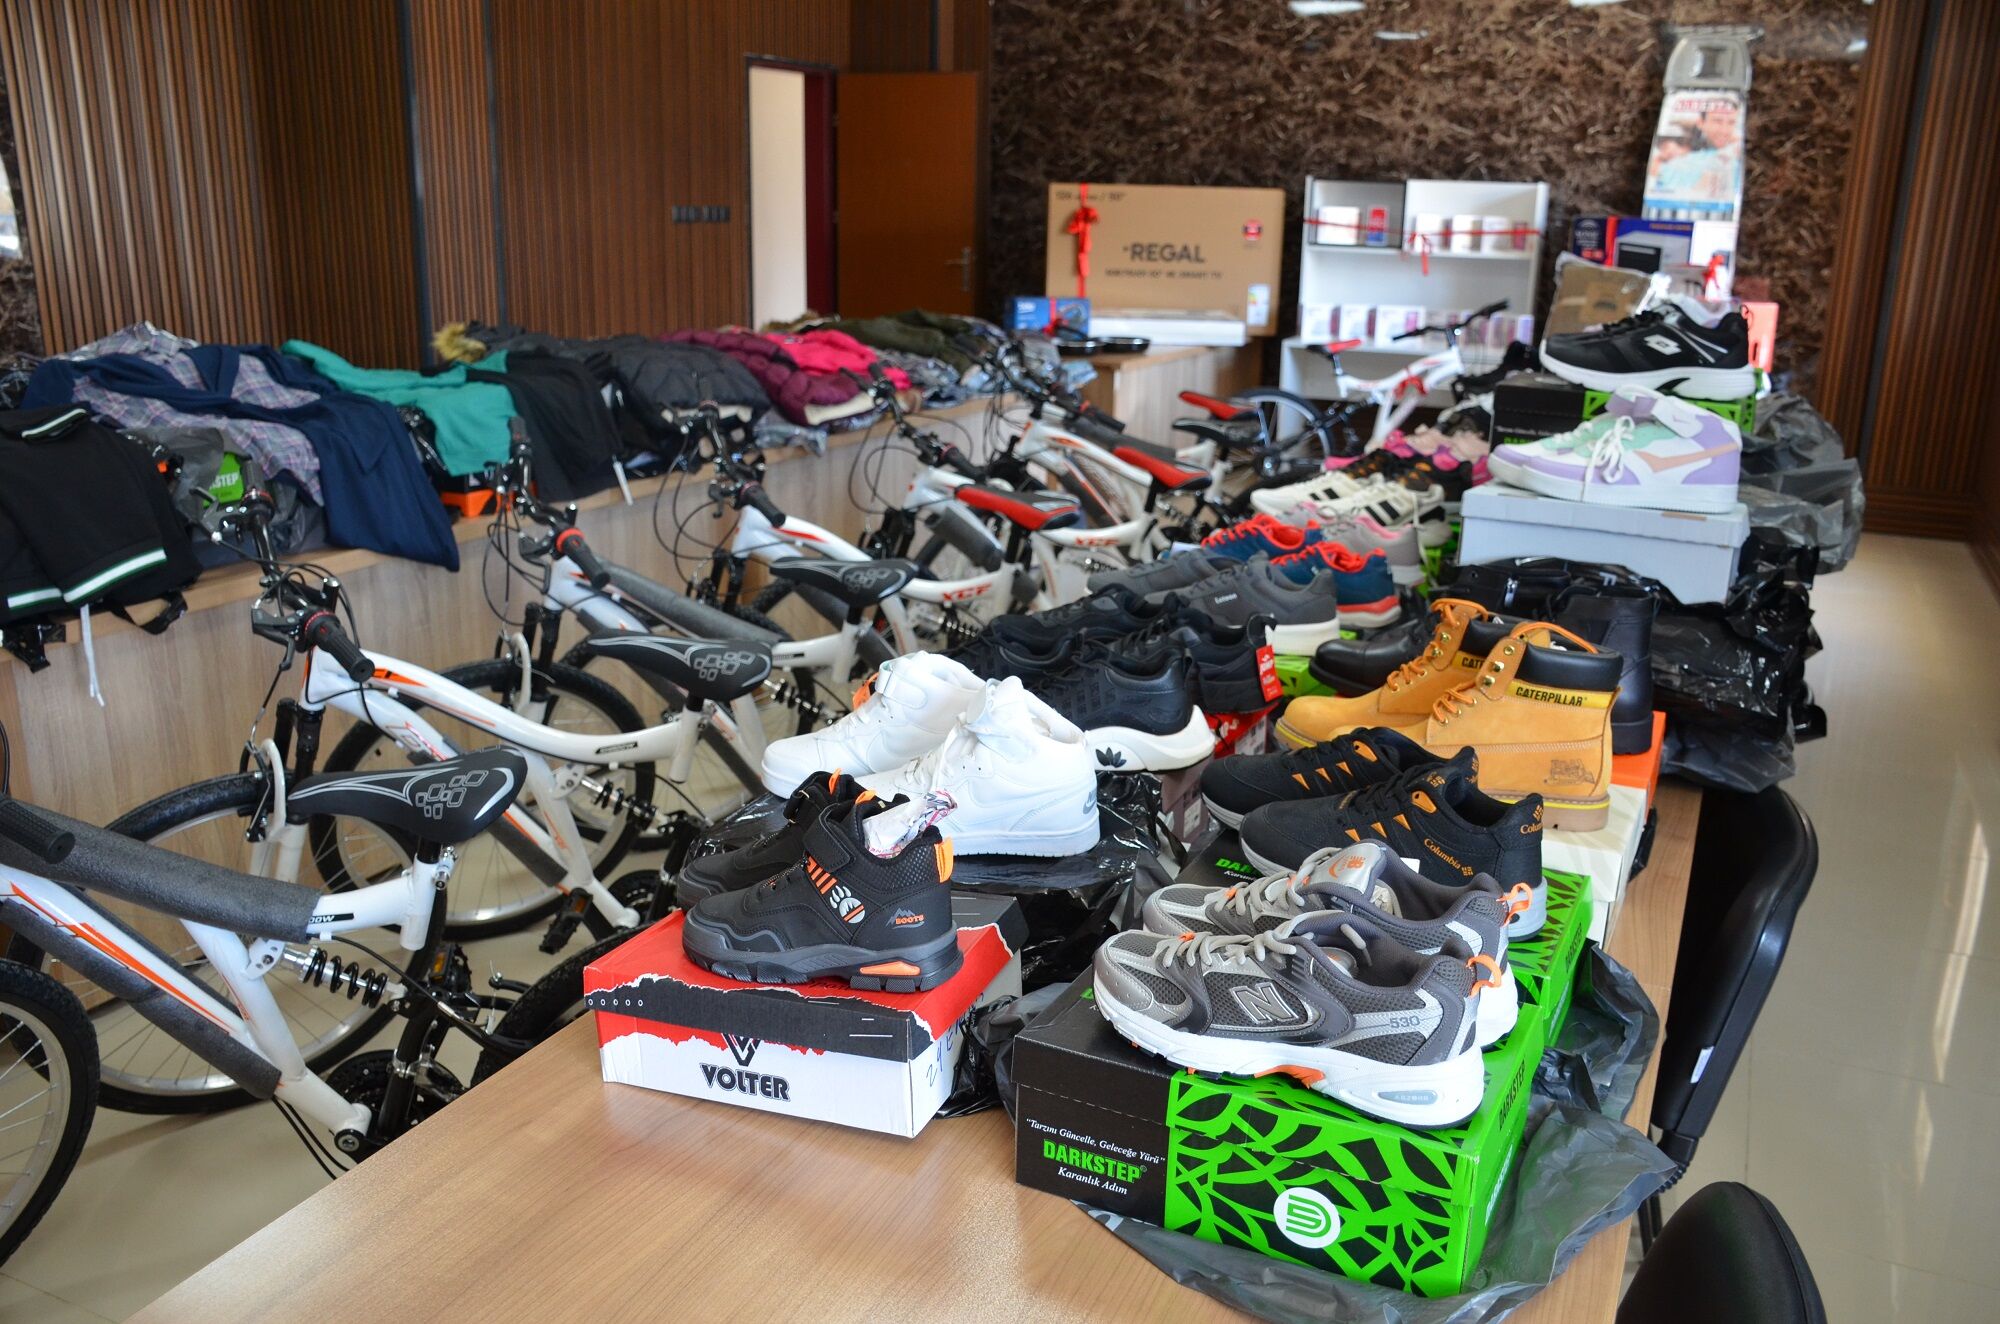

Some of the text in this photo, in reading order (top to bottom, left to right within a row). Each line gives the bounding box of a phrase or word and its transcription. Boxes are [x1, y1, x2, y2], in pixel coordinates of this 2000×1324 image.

[1130, 243, 1206, 264] REGAL
[1424, 838, 1461, 870] Columbia
[895, 914, 924, 925] BOOTS
[1389, 1016, 1421, 1029] 530
[699, 1063, 791, 1102] VOLTER
[1059, 1128, 1097, 1147] Güncelle,
[1099, 1140, 1138, 1158] Geleceğe
[1057, 1166, 1128, 1195] Karanlık Adım
